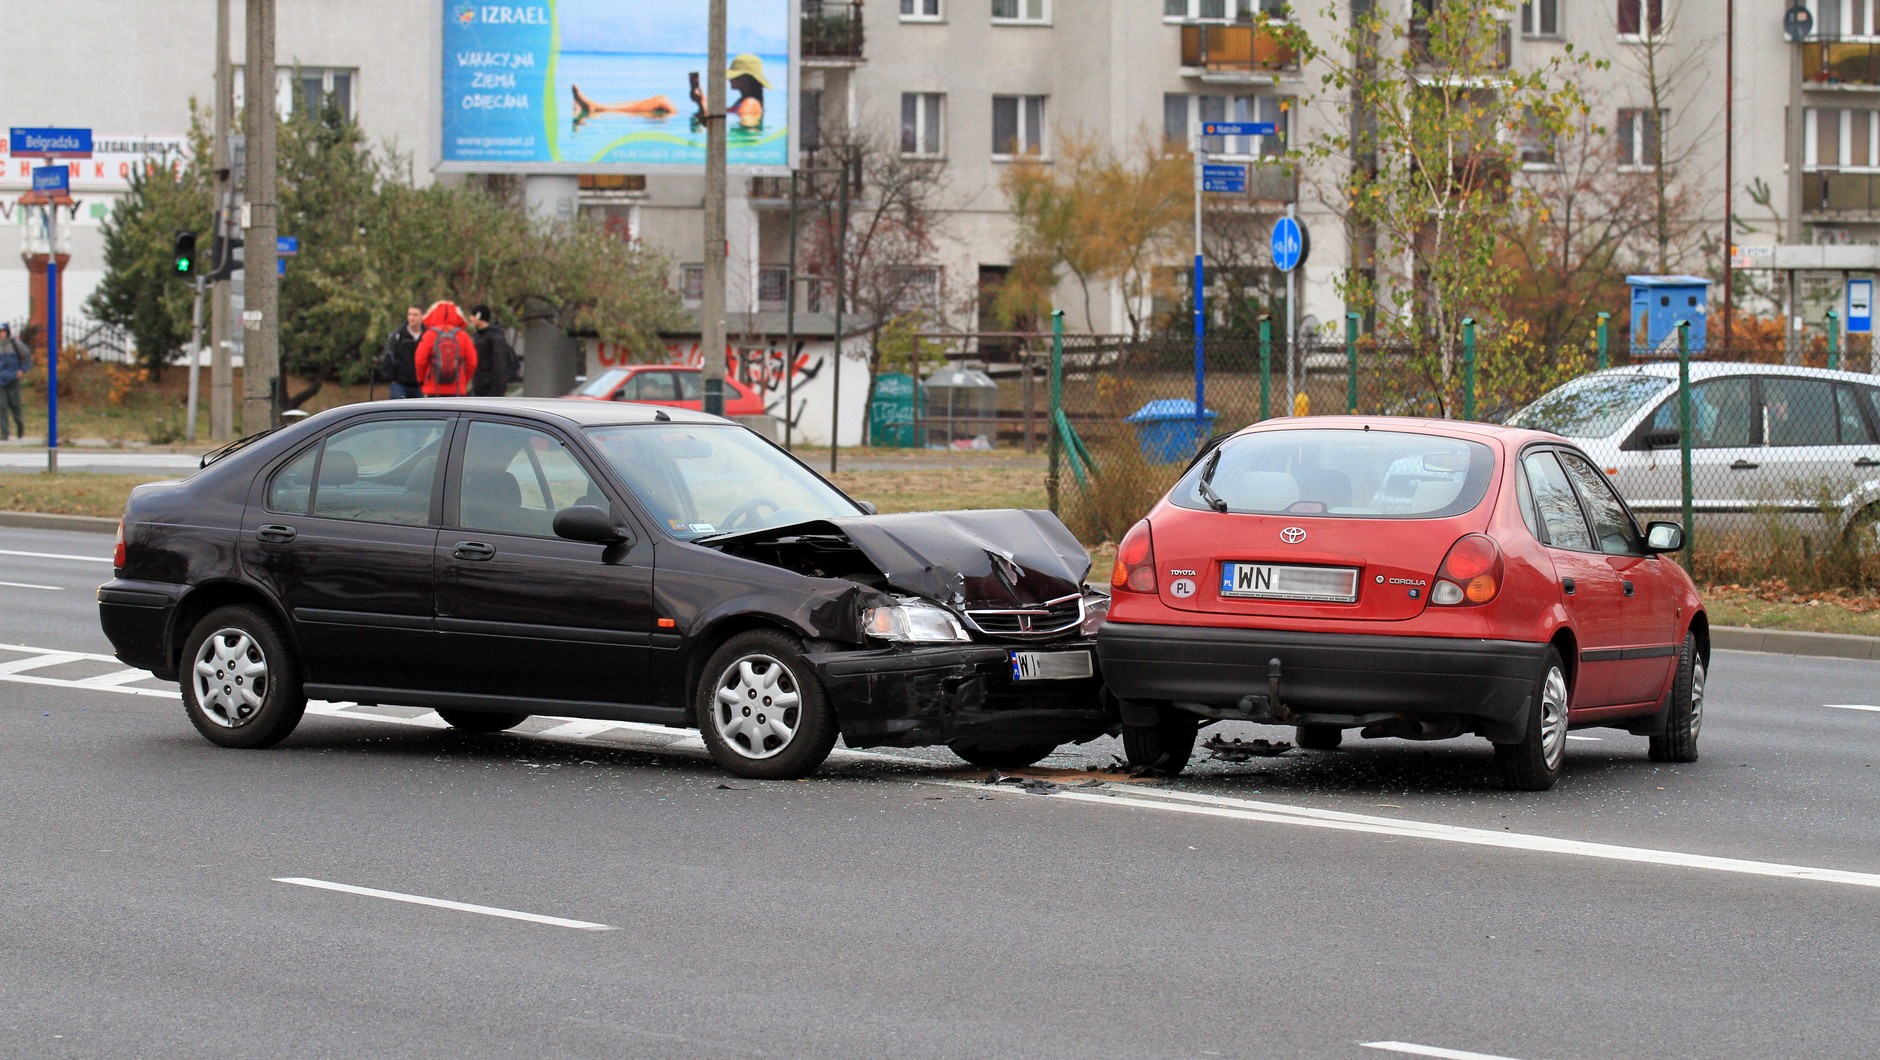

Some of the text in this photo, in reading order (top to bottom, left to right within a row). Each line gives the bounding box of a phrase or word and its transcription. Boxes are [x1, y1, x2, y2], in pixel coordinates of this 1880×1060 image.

[481, 6, 549, 25] IZRAEL
[456, 51, 535, 68] WAKACYJNA
[471, 71, 516, 89] ZIEMIA
[461, 93, 530, 110] OBIECANA
[25, 134, 80, 151] Belgradzka
[1223, 566, 1272, 590] PL WN
[1389, 577, 1426, 586] COROLLA
[1176, 582, 1190, 594] PL
